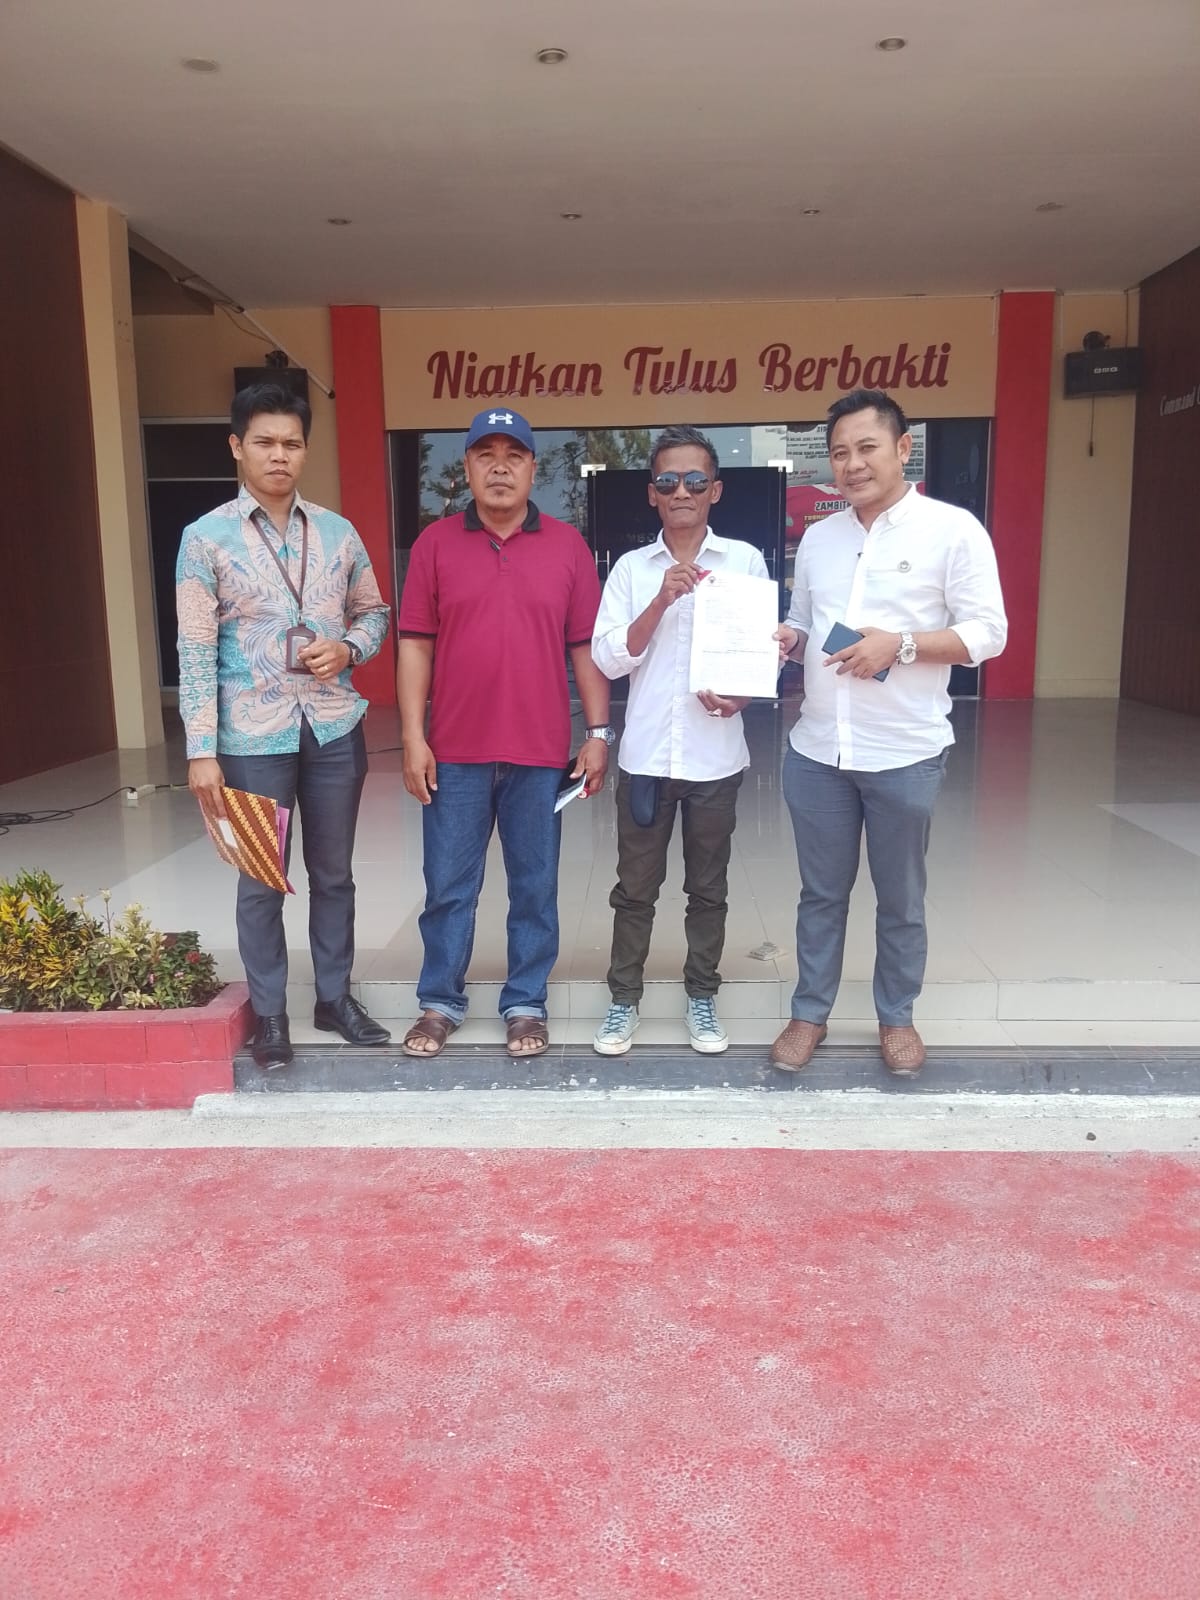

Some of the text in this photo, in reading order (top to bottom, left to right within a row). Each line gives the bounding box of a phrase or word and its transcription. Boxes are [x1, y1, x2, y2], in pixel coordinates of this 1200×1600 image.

[426, 342, 952, 399] Niatkan Tulus Berbakti
